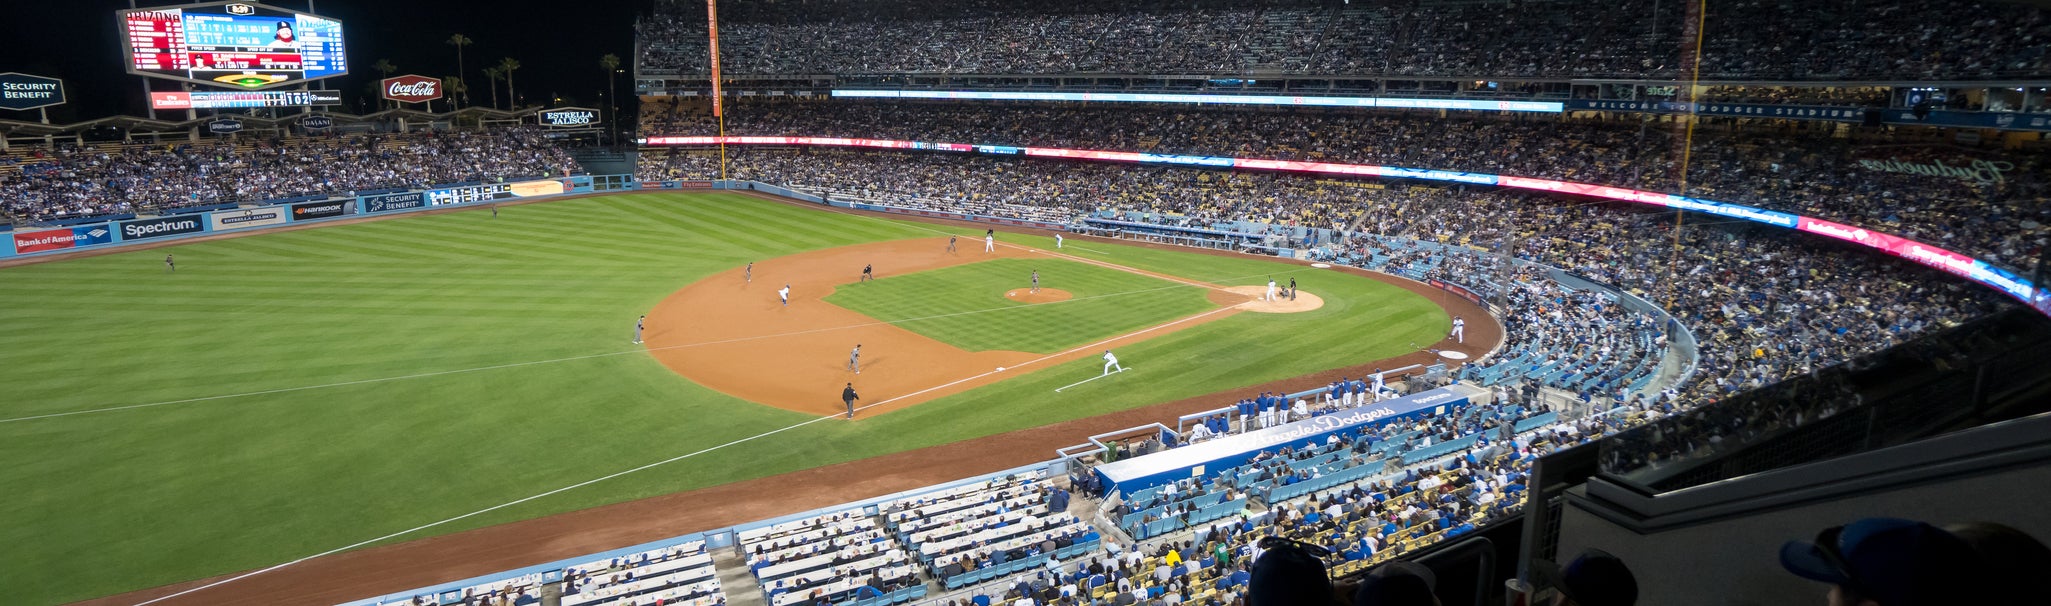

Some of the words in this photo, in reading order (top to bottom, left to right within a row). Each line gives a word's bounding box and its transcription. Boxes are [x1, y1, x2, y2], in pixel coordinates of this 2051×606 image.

[2, 82, 56, 91] SECURITY
[388, 81, 436, 96] Coca-Cola
[4, 91, 51, 99] BENEFIT
[1588, 101, 1659, 110] WELCOME
[1699, 103, 1763, 114] DODGER
[1776, 107, 1853, 118] STADIUM
[546, 111, 594, 120] ESTRELLA
[552, 117, 590, 125] JALISCO
[385, 194, 420, 203] SECURITY
[386, 200, 416, 210] BENEFIT
[126, 220, 195, 237] Spectrum
[17, 238, 41, 247] Bank
[42, 236, 51, 244] of
[51, 233, 88, 244] America
[1312, 407, 1396, 430] Dodgers
